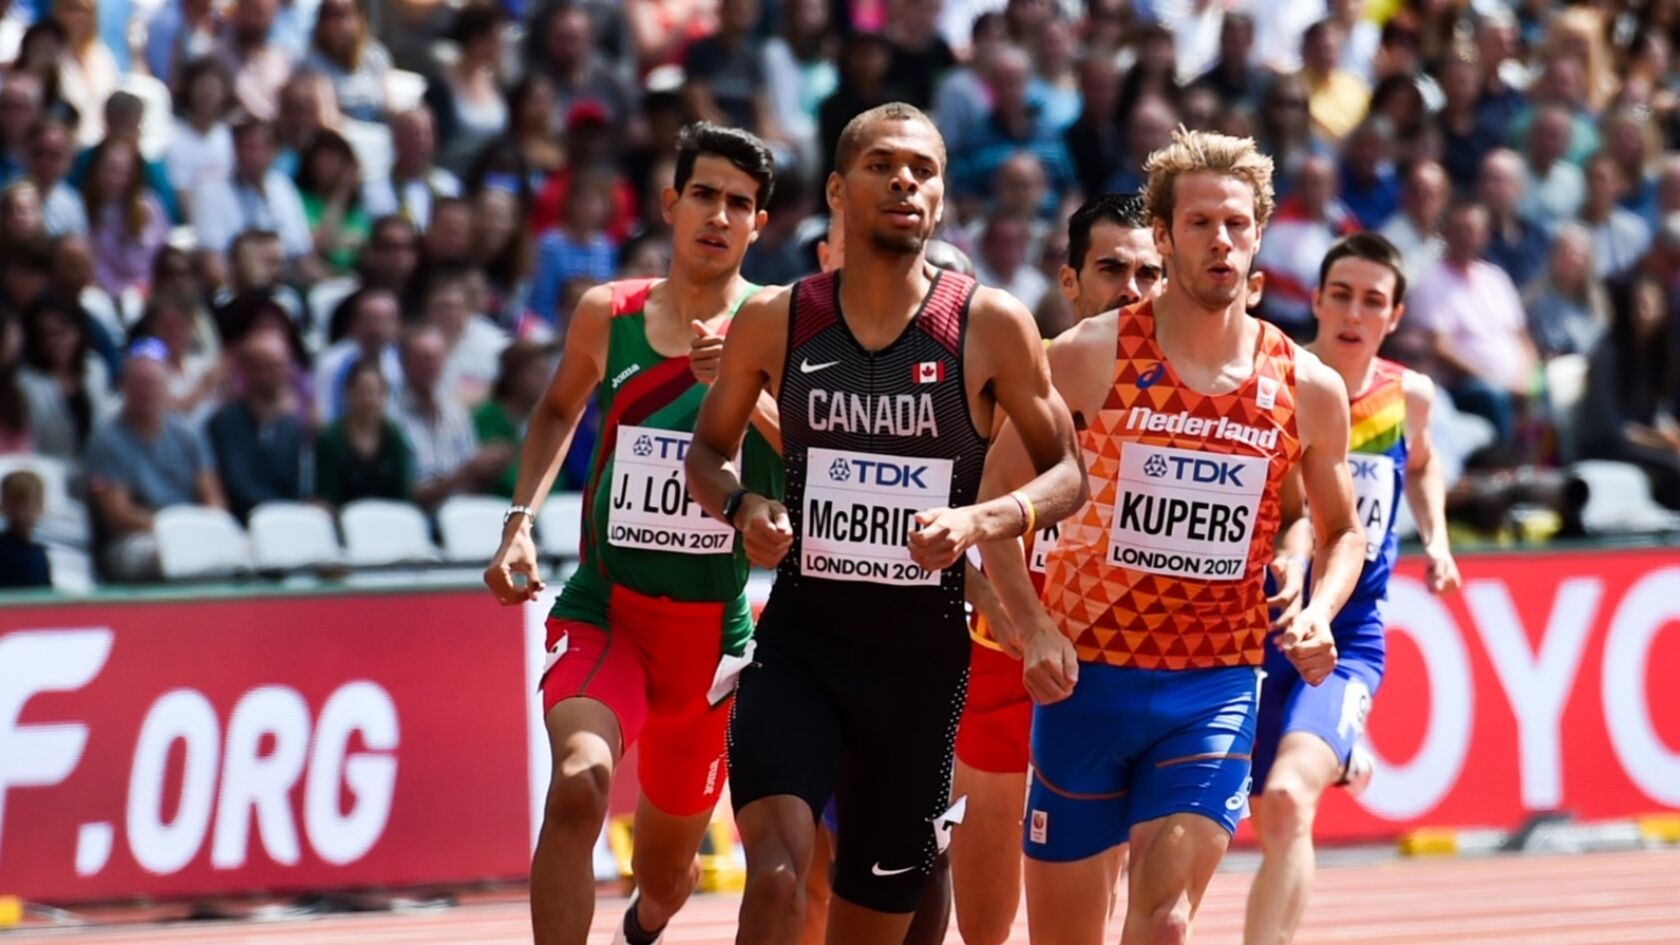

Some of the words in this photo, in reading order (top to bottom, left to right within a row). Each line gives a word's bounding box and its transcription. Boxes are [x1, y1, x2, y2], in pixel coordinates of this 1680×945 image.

[807, 388, 938, 438] CANADA
[851, 459, 928, 489] TDK
[1168, 456, 1246, 487] TDK
[613, 473, 632, 510] J.
[643, 470, 712, 518] LÓP
[808, 498, 926, 547] McBRID
[1119, 490, 1249, 543] KUPERS
[611, 525, 686, 547] LONDON
[690, 533, 729, 549] 2017
[806, 555, 888, 578] LONDON
[1113, 546, 1200, 573] LONDON
[1204, 559, 1242, 575] 2017
